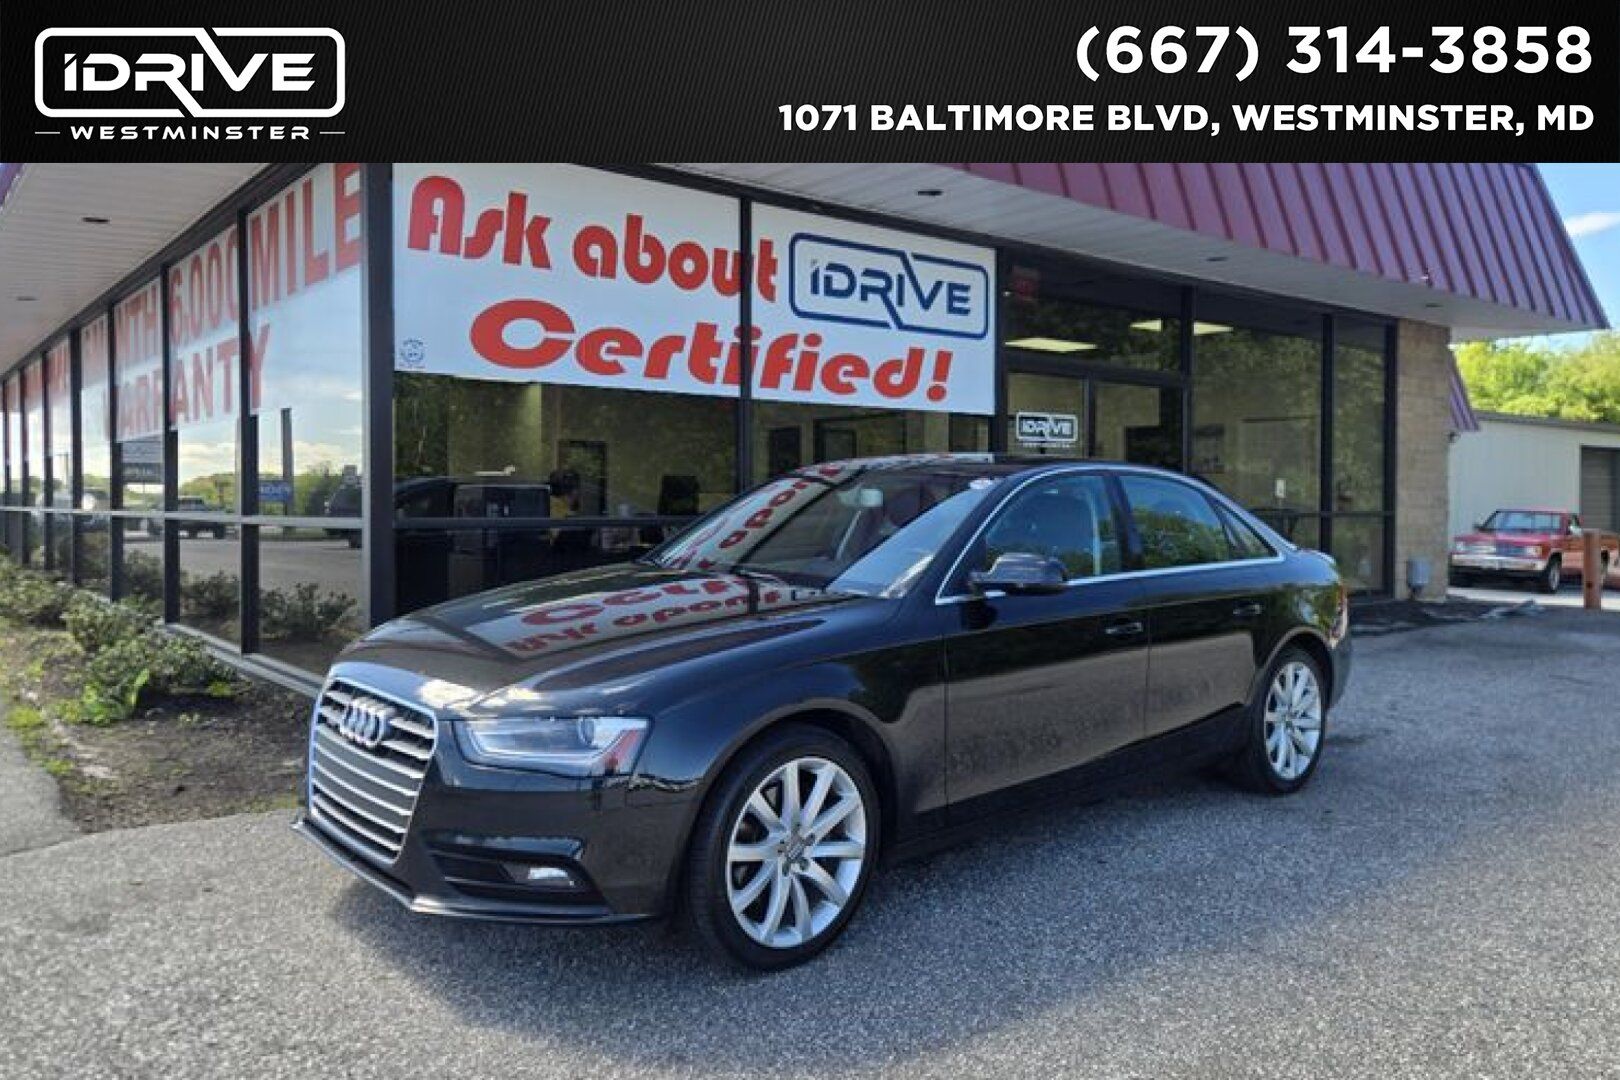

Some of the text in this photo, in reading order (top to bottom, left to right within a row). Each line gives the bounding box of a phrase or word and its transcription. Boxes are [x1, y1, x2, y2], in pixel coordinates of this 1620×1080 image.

[251, 163, 362, 312] MILE
[407, 175, 553, 271] Ask
[573, 212, 779, 303] about
[469, 297, 953, 402] Certified!
